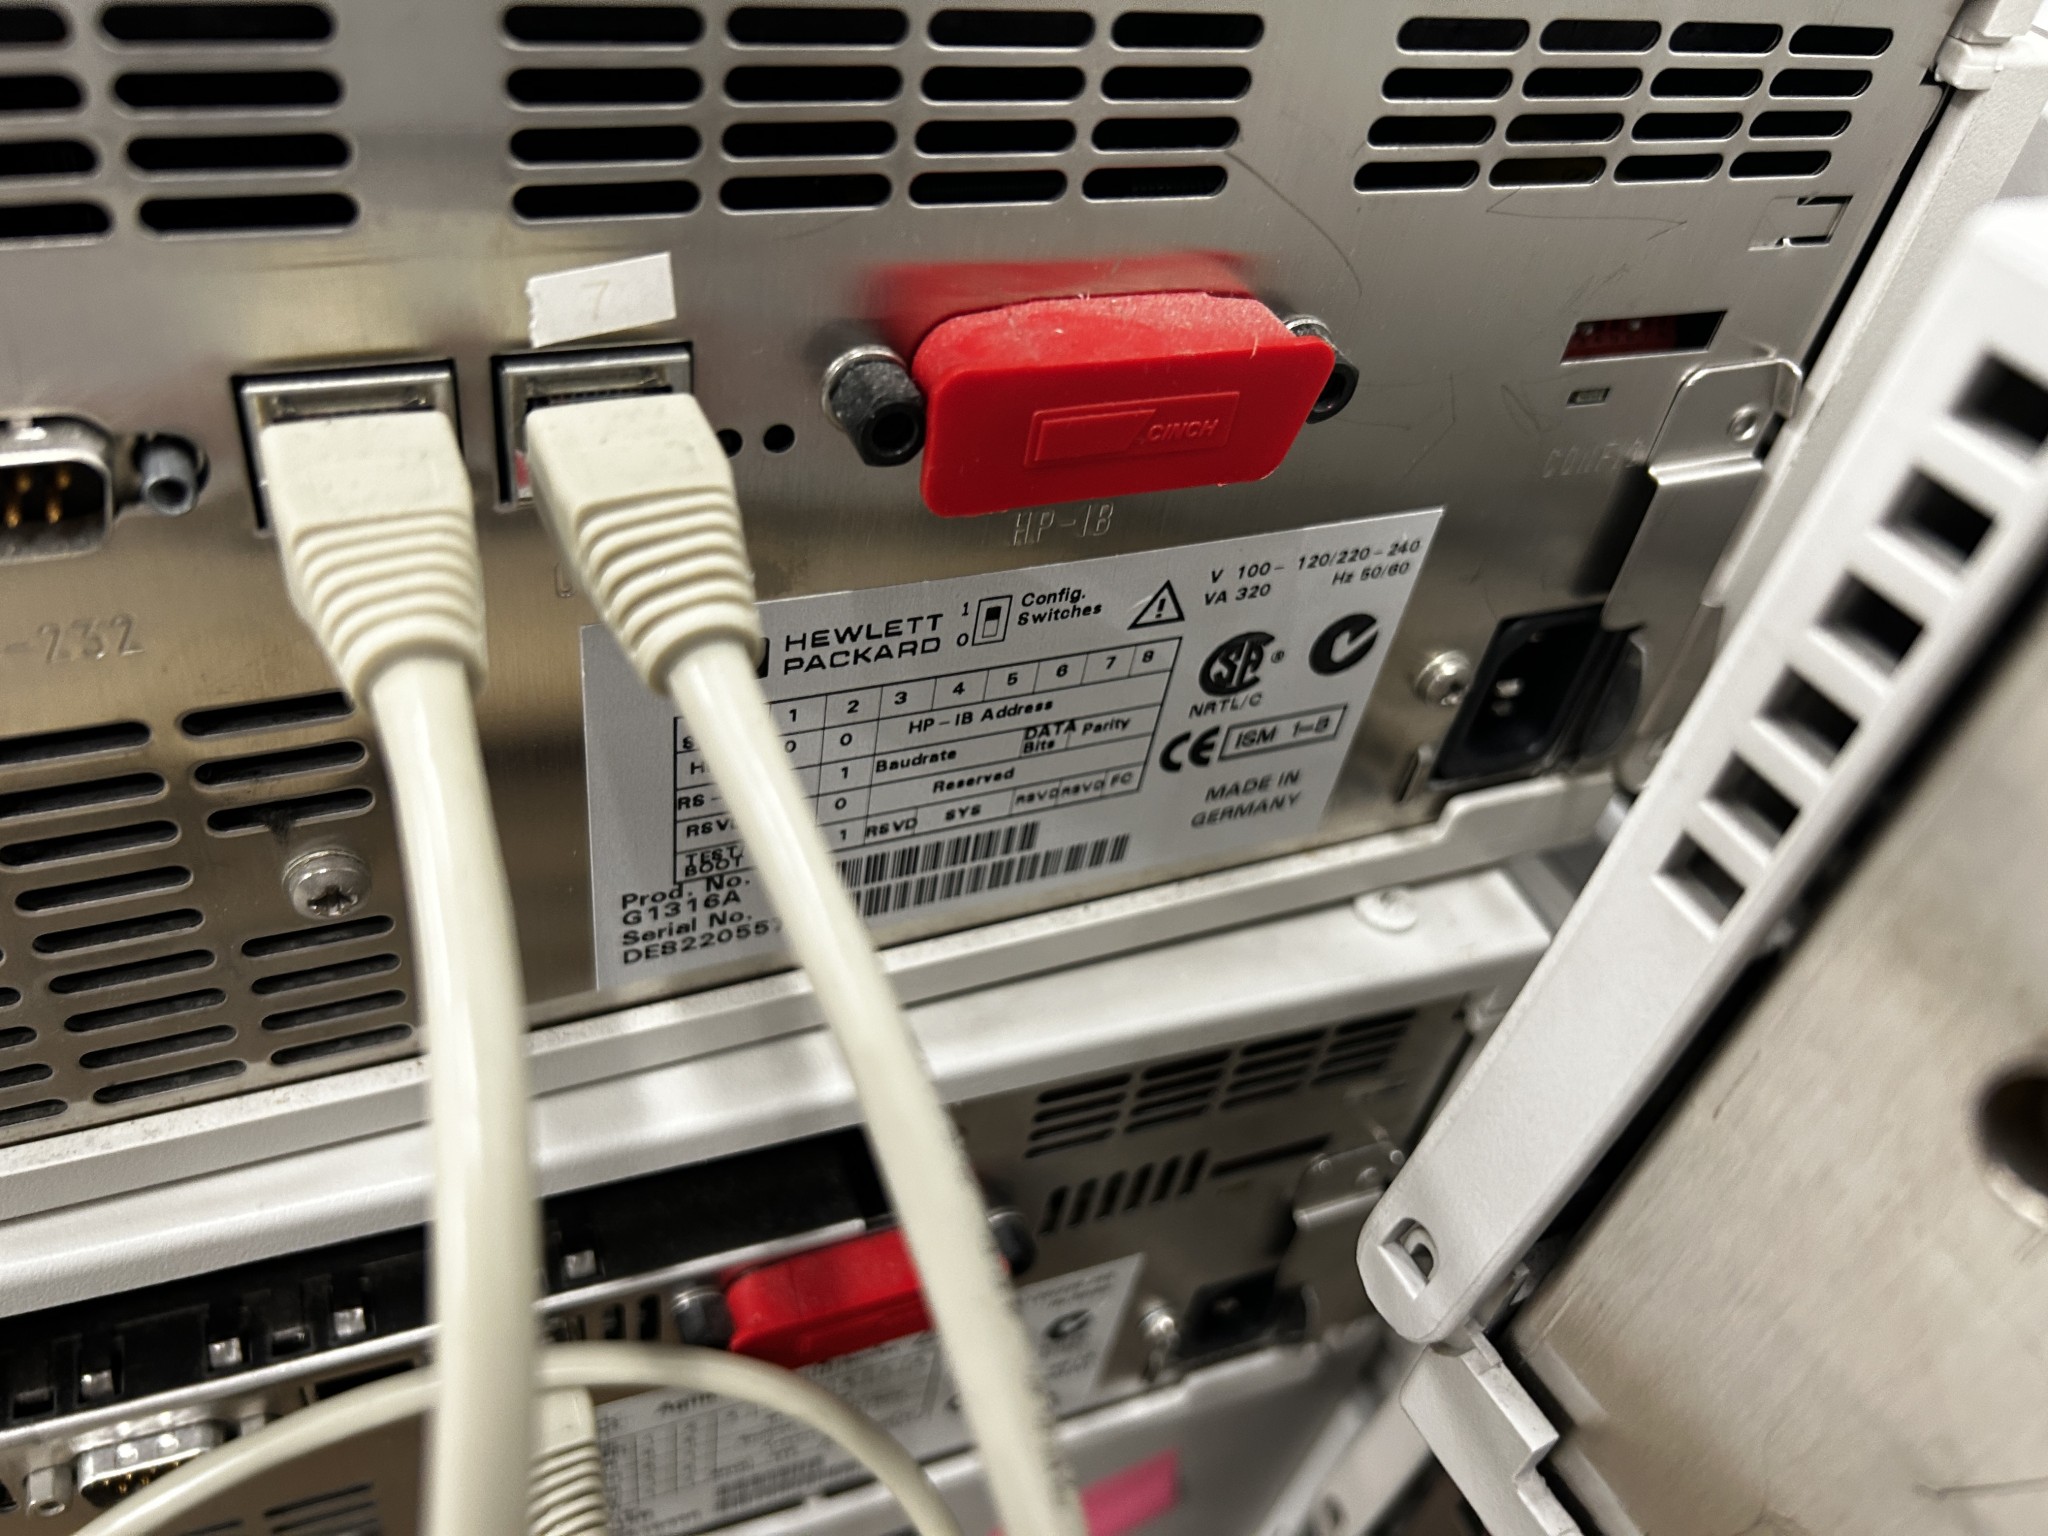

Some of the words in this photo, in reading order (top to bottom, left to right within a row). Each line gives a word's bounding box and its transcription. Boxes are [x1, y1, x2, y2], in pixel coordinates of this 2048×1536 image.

[579, 278, 609, 321] 7
[1149, 418, 1219, 441] CINCH
[1013, 502, 1114, 546] HP-IB
[1211, 569, 1224, 584] V
[1332, 571, 1353, 586] Hz
[1360, 562, 1410, 581] 50/60
[1021, 587, 1086, 607] Config.
[1205, 590, 1227, 606] VA
[1236, 583, 1271, 601] 320
[961, 602, 969, 617] 1
[1017, 604, 1102, 626] Switches
[785, 613, 943, 652] HEWLETT
[784, 637, 941, 676] PACKARD
[789, 708, 797, 723] 1
[847, 700, 860, 714] 2
[894, 691, 908, 705] 3
[952, 682, 966, 696] 4
[1007, 672, 1019, 686] 5
[1056, 664, 1069, 678] 6
[1105, 656, 1117, 670] 7
[1142, 650, 1154, 664] 8
[980, 700, 1053, 722] Address
[1188, 692, 1263, 719] NRTL/C
[1024, 719, 1077, 740] DATA
[1081, 718, 1130, 736] Parity
[1235, 726, 1277, 750] ISM
[841, 767, 849, 779] 1
[875, 749, 957, 774] Baudrate
[932, 768, 1015, 793] Reserved
[1205, 774, 1272, 803] MADE
[1278, 769, 1301, 787] IN
[840, 829, 847, 841] 1
[865, 818, 918, 839] RSVD
[945, 804, 982, 822] SYS
[1191, 791, 1301, 828] GERMANY
[685, 855, 744, 877] BOOT
[621, 881, 693, 910] Prod.
[705, 875, 751, 893] No.
[622, 889, 742, 926] G1316A
[622, 917, 697, 946] Serial
[709, 911, 753, 929] No.
